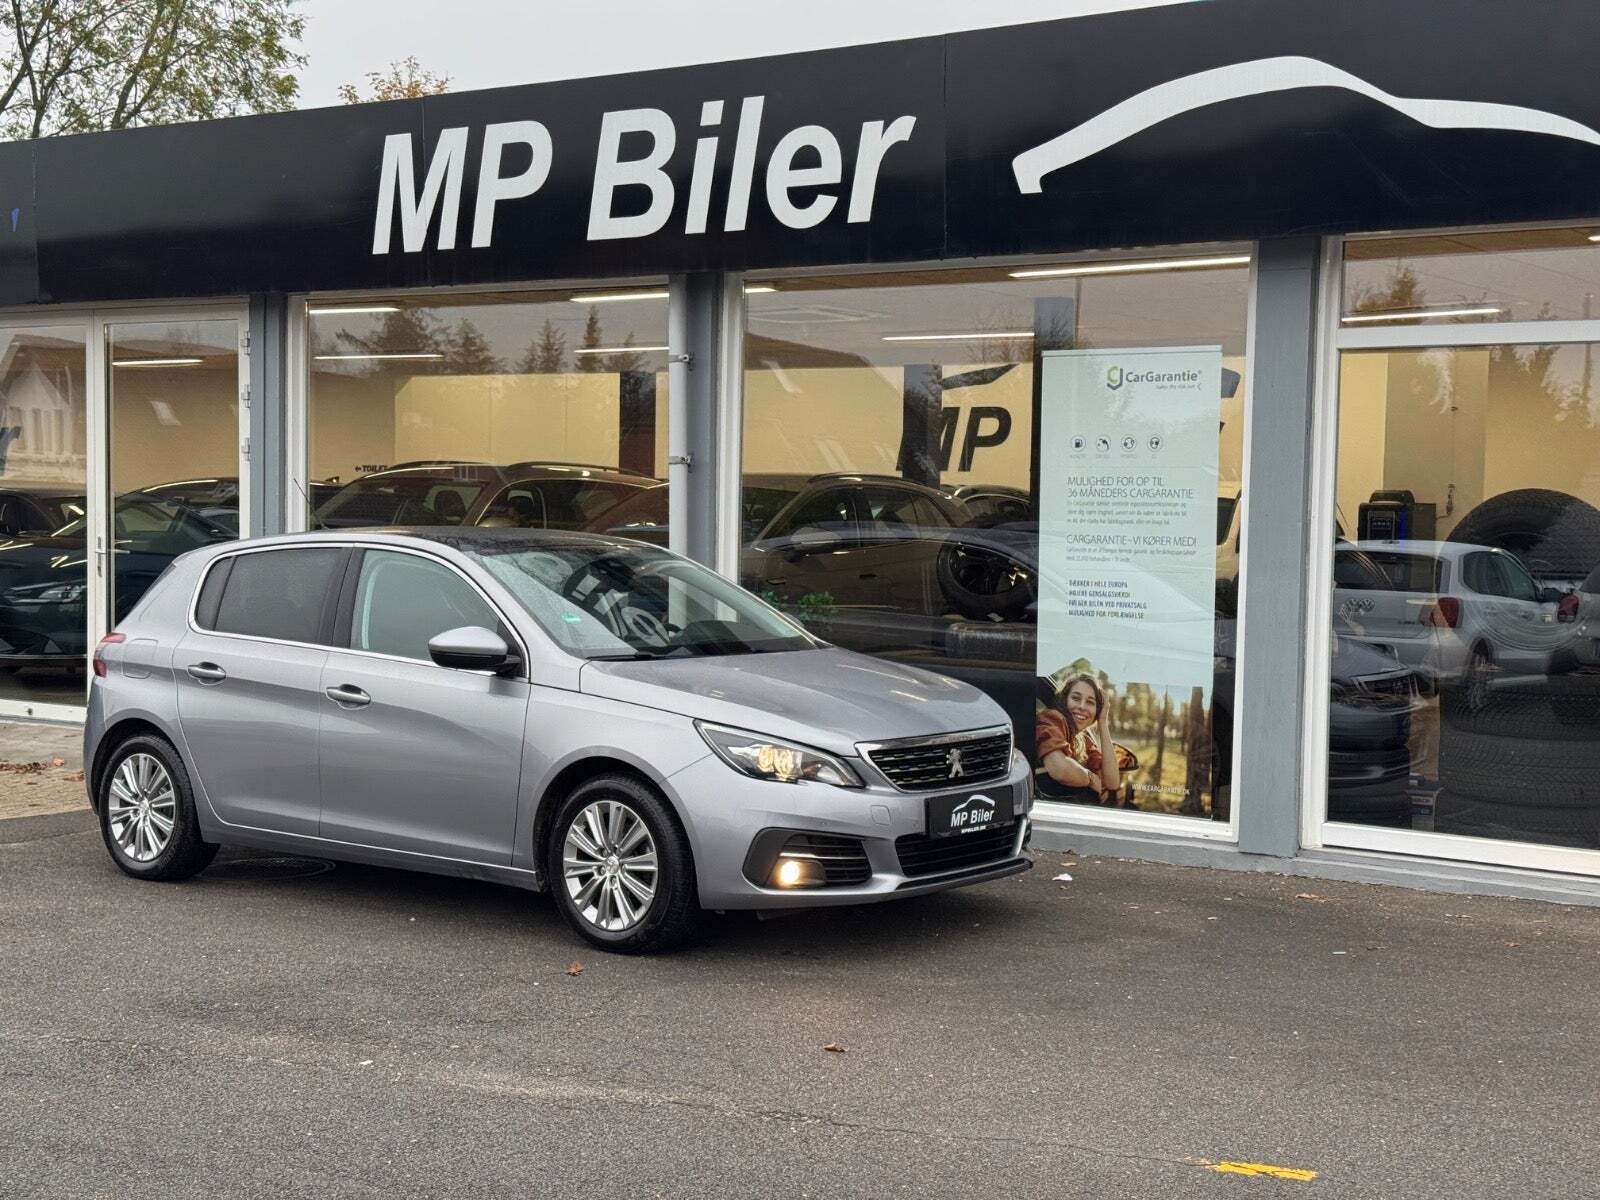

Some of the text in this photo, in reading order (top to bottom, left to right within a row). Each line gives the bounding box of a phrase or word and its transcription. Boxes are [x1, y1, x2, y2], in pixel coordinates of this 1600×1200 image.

[372, 95, 917, 255] MP Biler
[1126, 370, 1198, 382] CarGarantie
[1067, 476, 1164, 486] MULIGHED FOR OP TIL
[1068, 486, 1193, 498] 36 MÅNEDERS CARGARANTIE
[1066, 535, 1127, 545] CARGARANTIE
[1133, 535, 1141, 545] VI
[1143, 535, 1171, 546] KØRER
[951, 808, 995, 828] MP Biler
